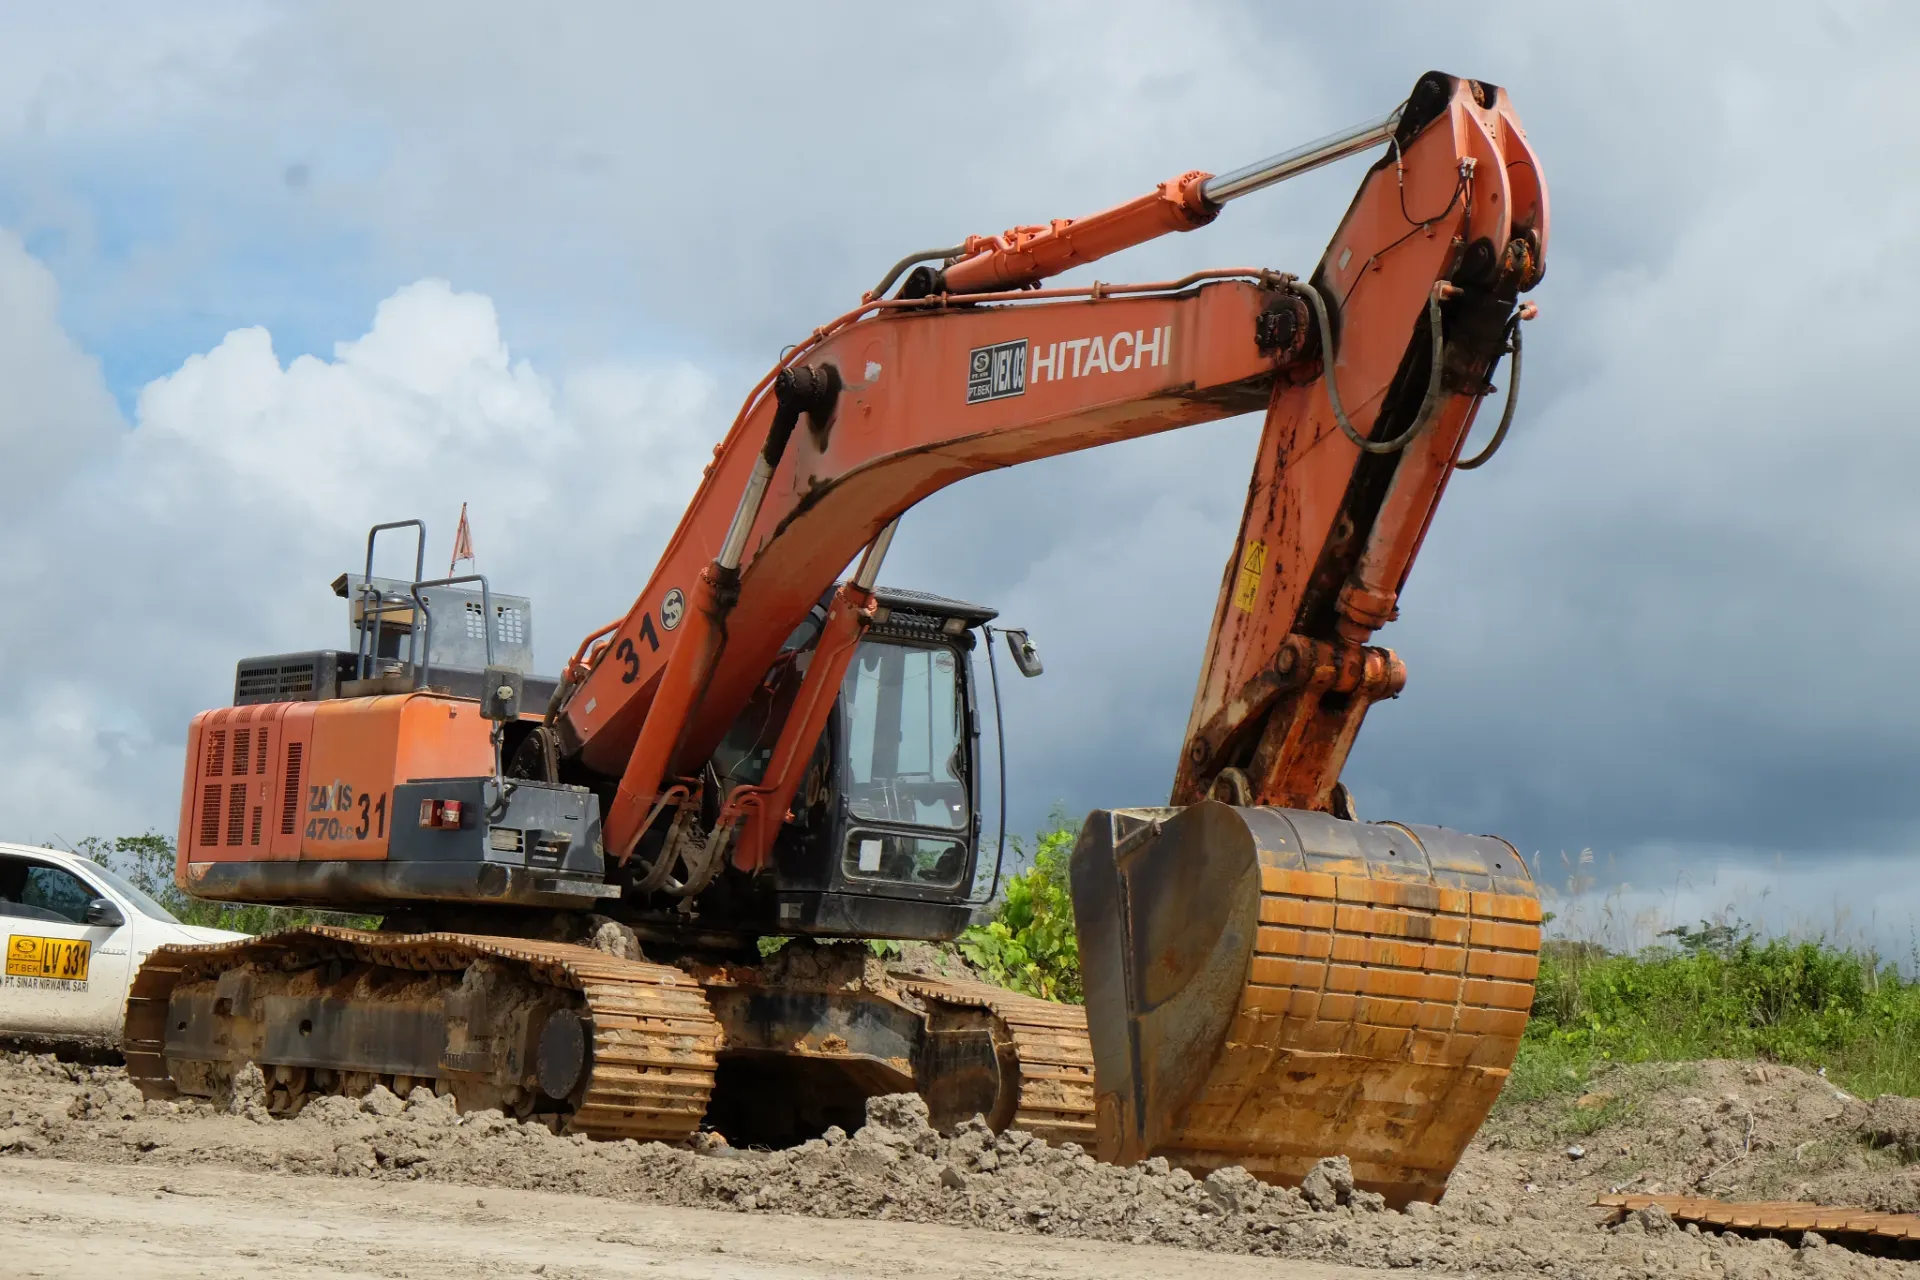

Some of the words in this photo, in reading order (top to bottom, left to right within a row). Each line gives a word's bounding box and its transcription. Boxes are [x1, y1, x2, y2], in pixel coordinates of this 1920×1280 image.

[994, 349, 1012, 392] VEX
[1012, 346, 1026, 389] 03
[1031, 326, 1172, 384] HITACHI
[616, 611, 660, 684] 31
[310, 779, 352, 811] ZAXIS
[355, 791, 387, 840] 31
[43, 942, 61, 974] LV
[63, 944, 87, 976] 331
[16, 977, 38, 989] SINAR
[39, 979, 71, 992] NIRWANA
[72, 981, 89, 993] SARI
